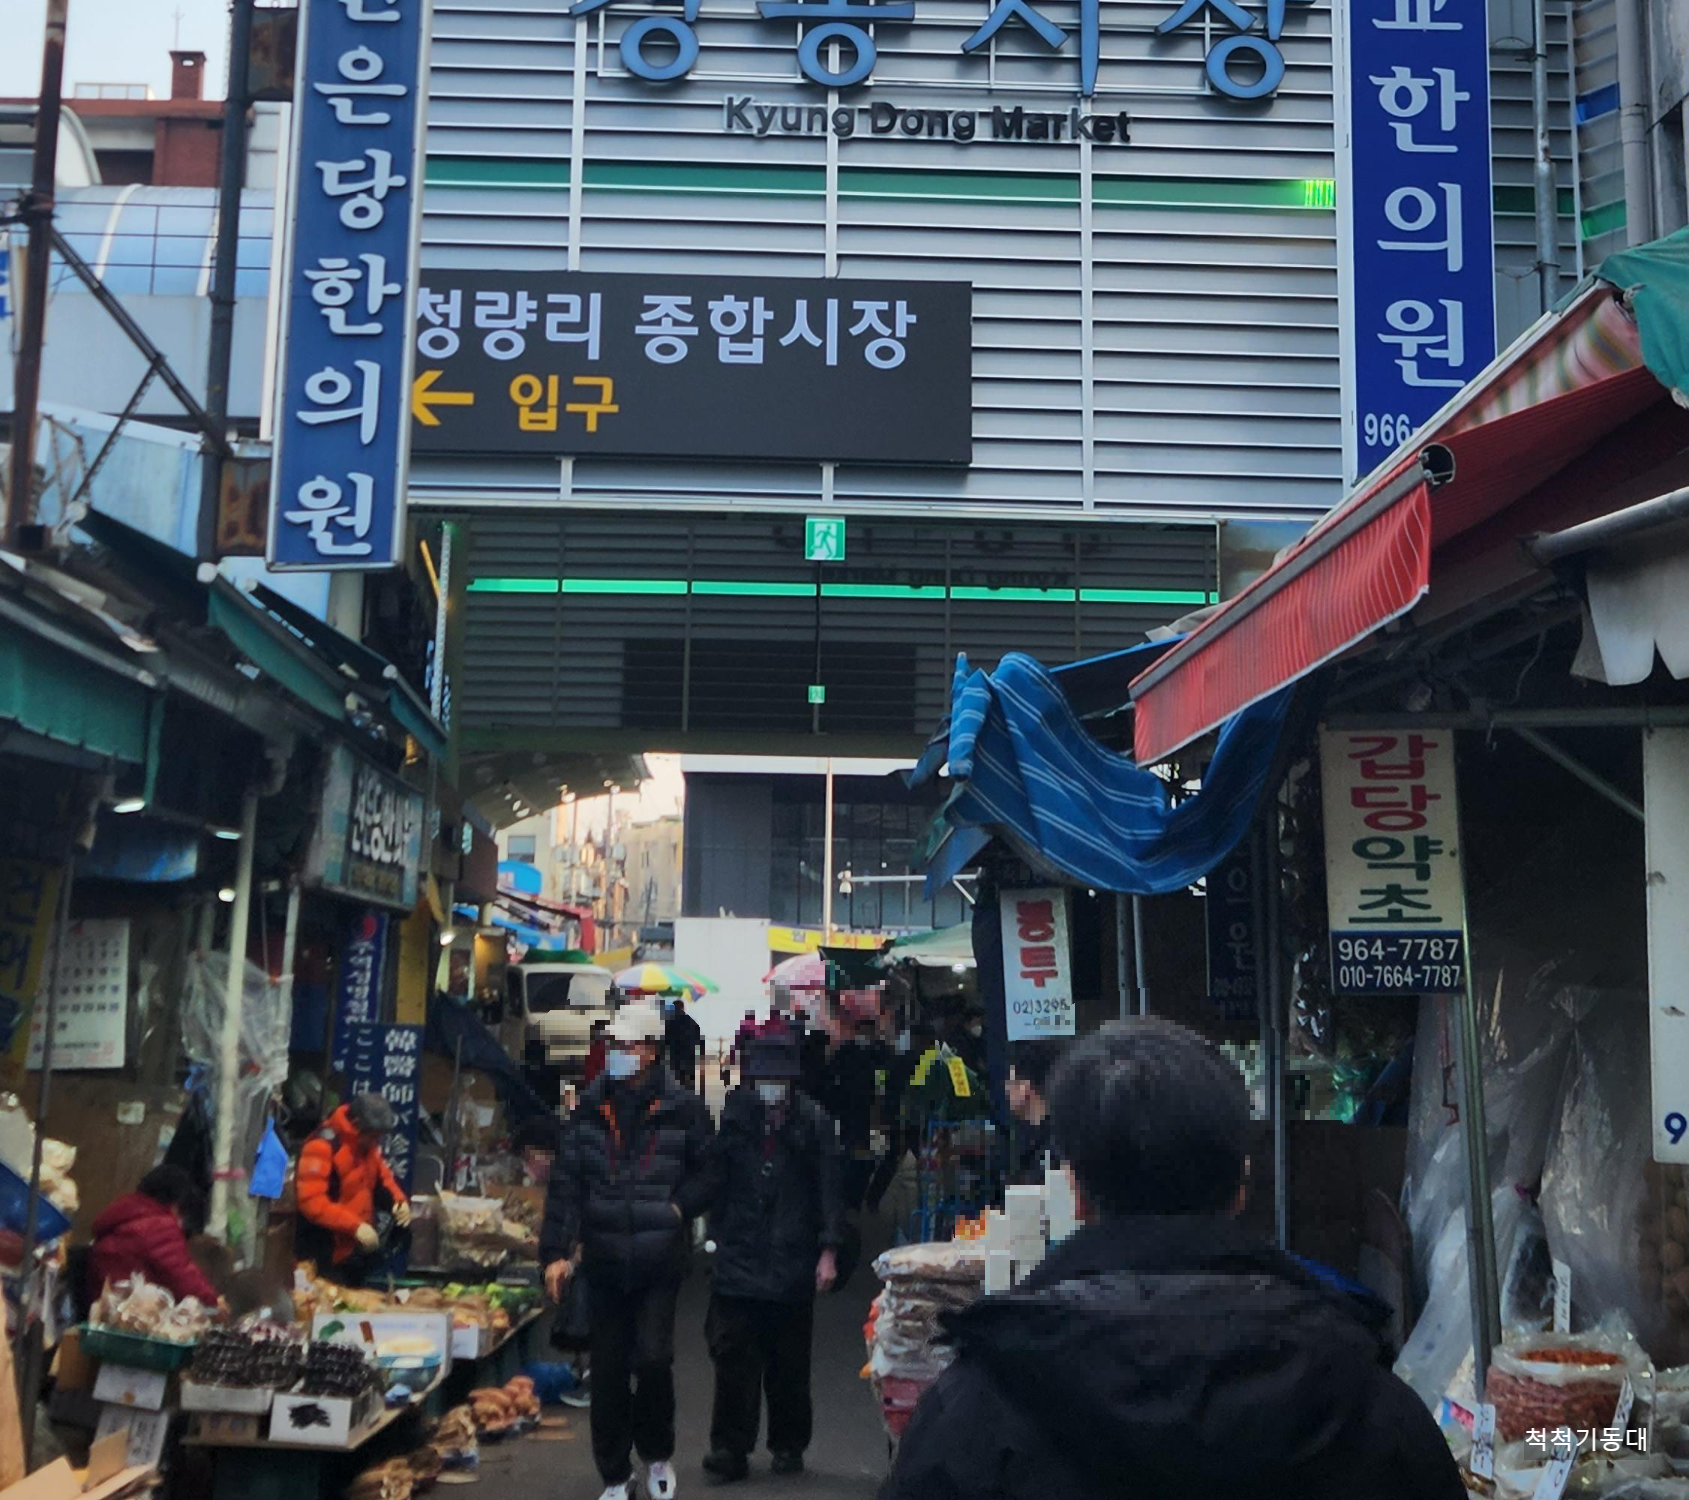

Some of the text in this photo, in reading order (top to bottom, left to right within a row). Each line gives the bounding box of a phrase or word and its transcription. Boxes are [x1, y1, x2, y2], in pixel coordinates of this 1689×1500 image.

[724, 95, 1133, 143] Kyung Dong Market
[416, 288, 917, 370] 청량리 종합시장
[509, 374, 620, 432] 입구
[1347, 734, 1443, 924] 갑당약초
[1338, 939, 1459, 962] 964-7787
[1339, 966, 1461, 988] 010-7664-7787
